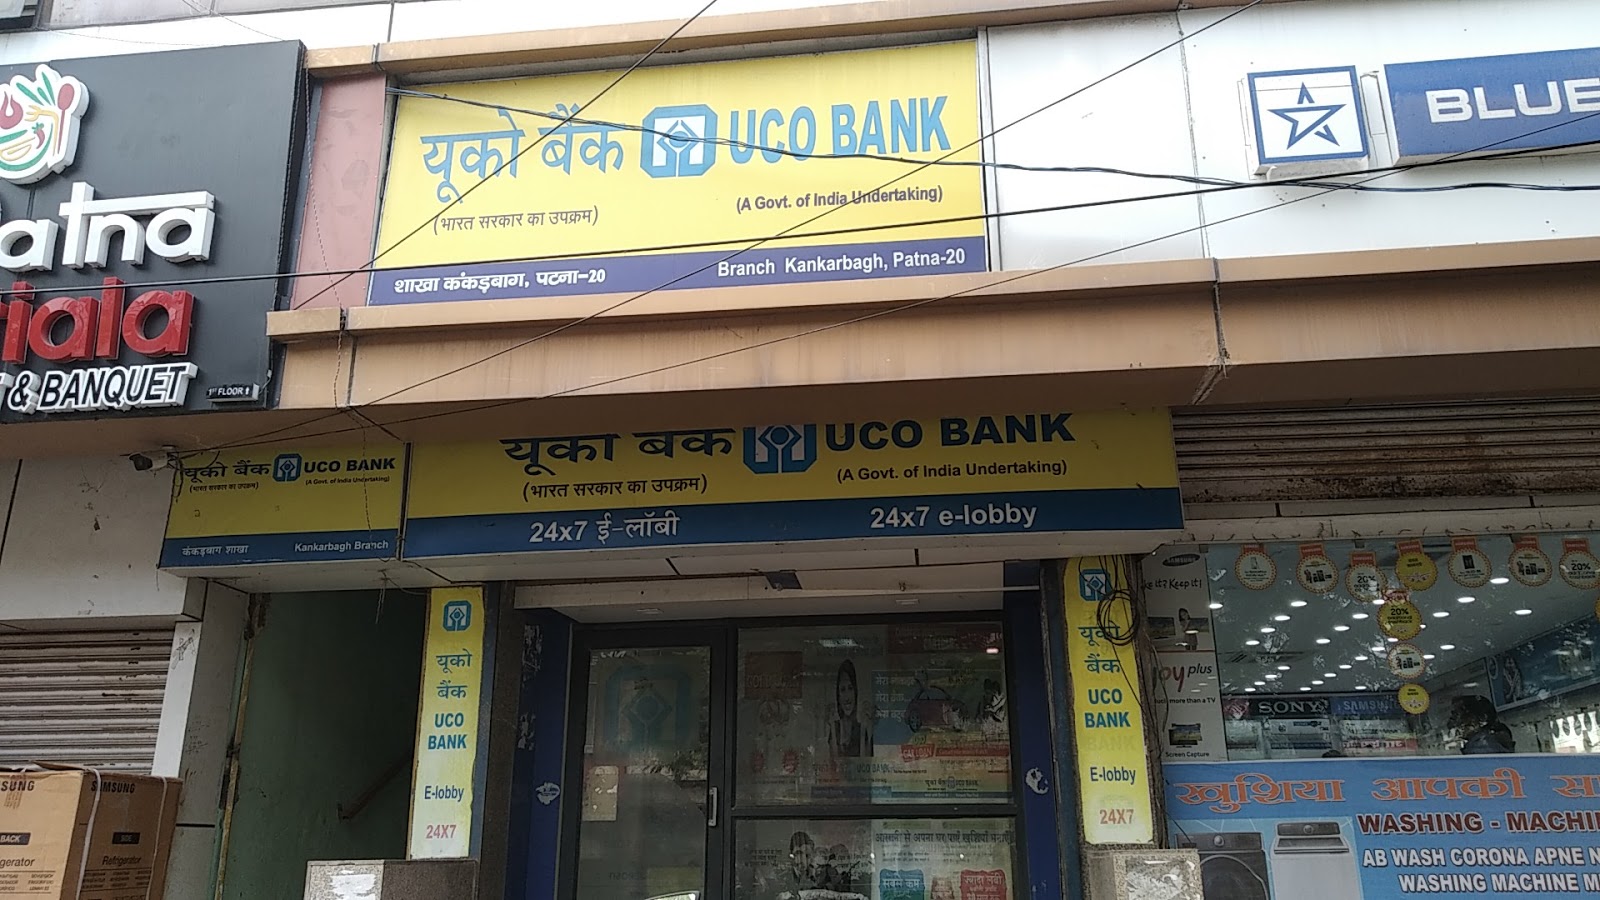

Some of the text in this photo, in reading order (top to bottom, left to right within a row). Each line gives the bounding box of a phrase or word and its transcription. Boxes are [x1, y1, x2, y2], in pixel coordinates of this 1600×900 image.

[1425, 77, 1600, 124] BLUE
[730, 96, 951, 164] UCO BANK
[420, 102, 625, 204] यूको बैंक
[736, 185, 943, 214] (A Govt. of India Undertaking)
[0, 182, 214, 271] atna
[433, 205, 599, 235] (भारत सरकार का उपक्रम)
[717, 247, 965, 277] Branch Kankarbagh, Patna-20
[394, 276, 440, 294] शाखा
[536, 268, 606, 287] पटना-20
[0, 277, 193, 364] iala
[7, 370, 41, 414] &
[39, 363, 197, 411] BANQUET
[218, 386, 244, 396] FLOOR
[825, 412, 1076, 451] UCO BANK
[183, 459, 272, 483] यूको बैंक
[304, 457, 396, 474] UCO BANK
[837, 459, 1067, 484] (A Govt. of India Undertaking)
[314, 478, 328, 486] Govt.
[337, 476, 352, 484] India
[523, 474, 708, 502] (भारत सरकार का उपक्रम)
[870, 503, 1037, 529] 24x7 e-lobby
[529, 520, 588, 543] 24x7
[294, 539, 389, 553] Kankarbagh Branch
[1571, 562, 1591, 571] 20%
[1169, 578, 1190, 589] Keep
[1391, 608, 1409, 616] 20%
[436, 648, 472, 673] यूको
[1085, 653, 1120, 674] बैंक
[1187, 663, 1213, 678] plus
[436, 679, 468, 699] बैंक
[1087, 688, 1122, 704] UCO
[1258, 700, 1321, 715] SONY
[434, 712, 464, 728] UCO
[1084, 711, 1130, 728] BANK
[427, 734, 467, 750] BANK
[1186, 751, 1210, 759] Capture
[1090, 766, 1136, 785] E-lobby
[1371, 767, 1526, 801] आपकी
[1550, 774, 1600, 799] स
[1, 780, 35, 792] SUNG
[424, 785, 464, 802] E-lobby
[1099, 809, 1134, 825] 24X7
[1356, 811, 1485, 834] WASHING
[1, 834, 21, 843] BACK
[426, 825, 457, 840] 24X7
[102, 854, 141, 868] Refrigerator
[1363, 849, 1388, 867] AB
[1391, 848, 1446, 867] WASH
[1450, 848, 1529, 867] CORONA
[1534, 847, 1585, 866] APNE
[1398, 873, 1487, 893] WASHING
[1490, 872, 1580, 892] MACHINE
